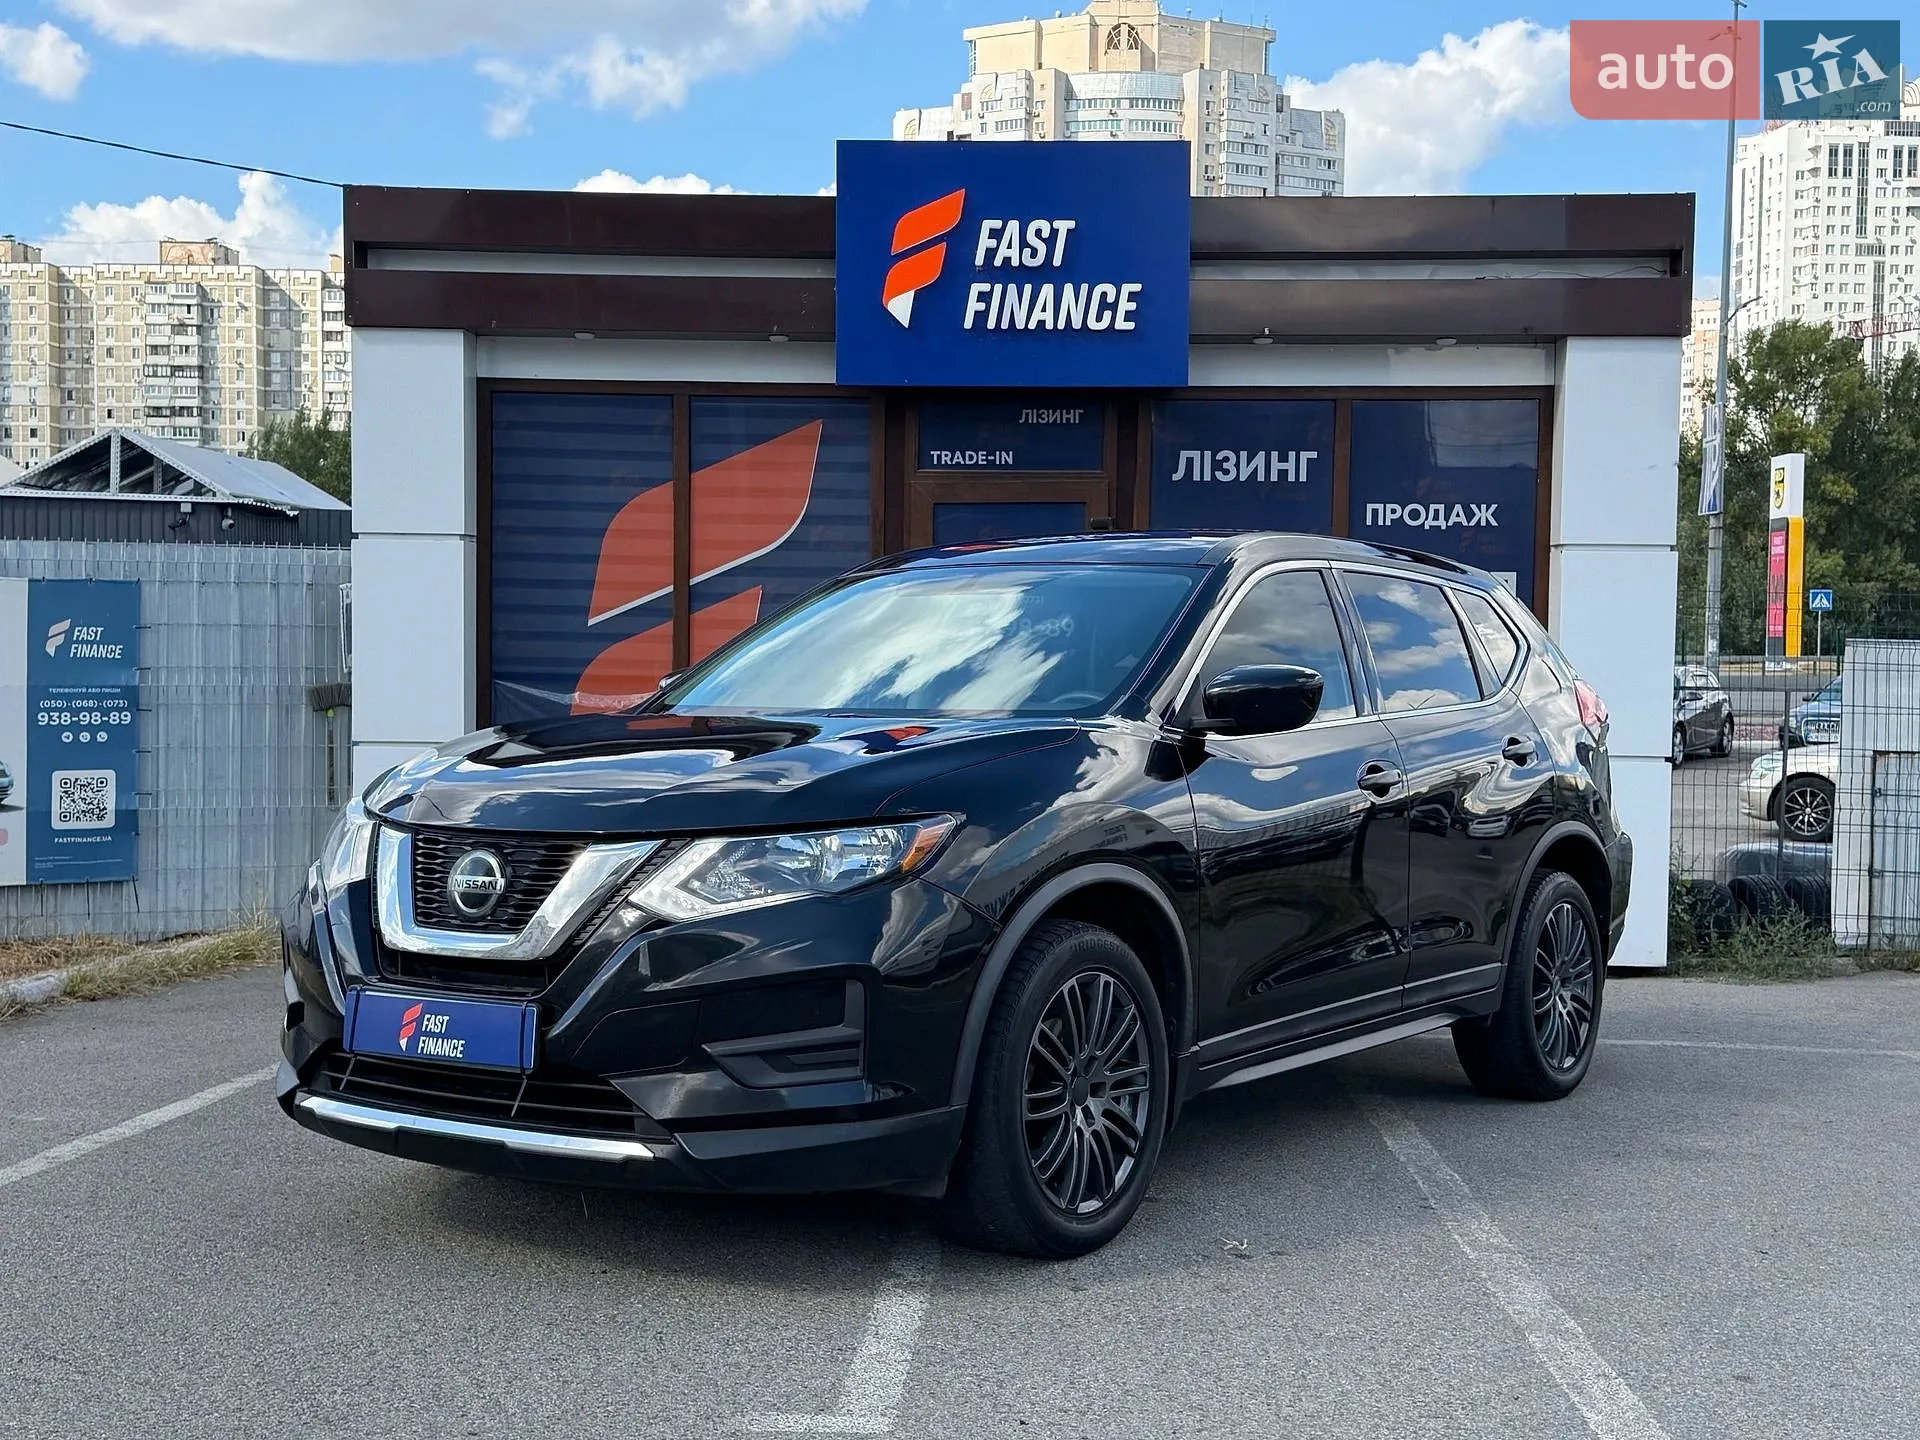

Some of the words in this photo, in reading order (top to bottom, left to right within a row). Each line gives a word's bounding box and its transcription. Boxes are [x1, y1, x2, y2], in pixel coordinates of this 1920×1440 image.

[974, 219, 1076, 267] FAST
[963, 282, 1142, 331] FINANCE
[1019, 409, 1084, 424] ЛІЗИНГ
[930, 451, 1013, 465] TRADE-IN
[1172, 450, 1318, 482] ЛІЗИНГ
[1365, 503, 1499, 530] ПРОДАЖ
[73, 627, 104, 641] FAST
[69, 644, 123, 659] FINANCE
[37, 711, 132, 726] 938-98-89
[54, 836, 112, 844] FASTFINANCE.UA
[455, 879, 498, 891] NISSAN
[422, 1014, 450, 1034] FAST
[417, 1036, 466, 1058] FINANCE
